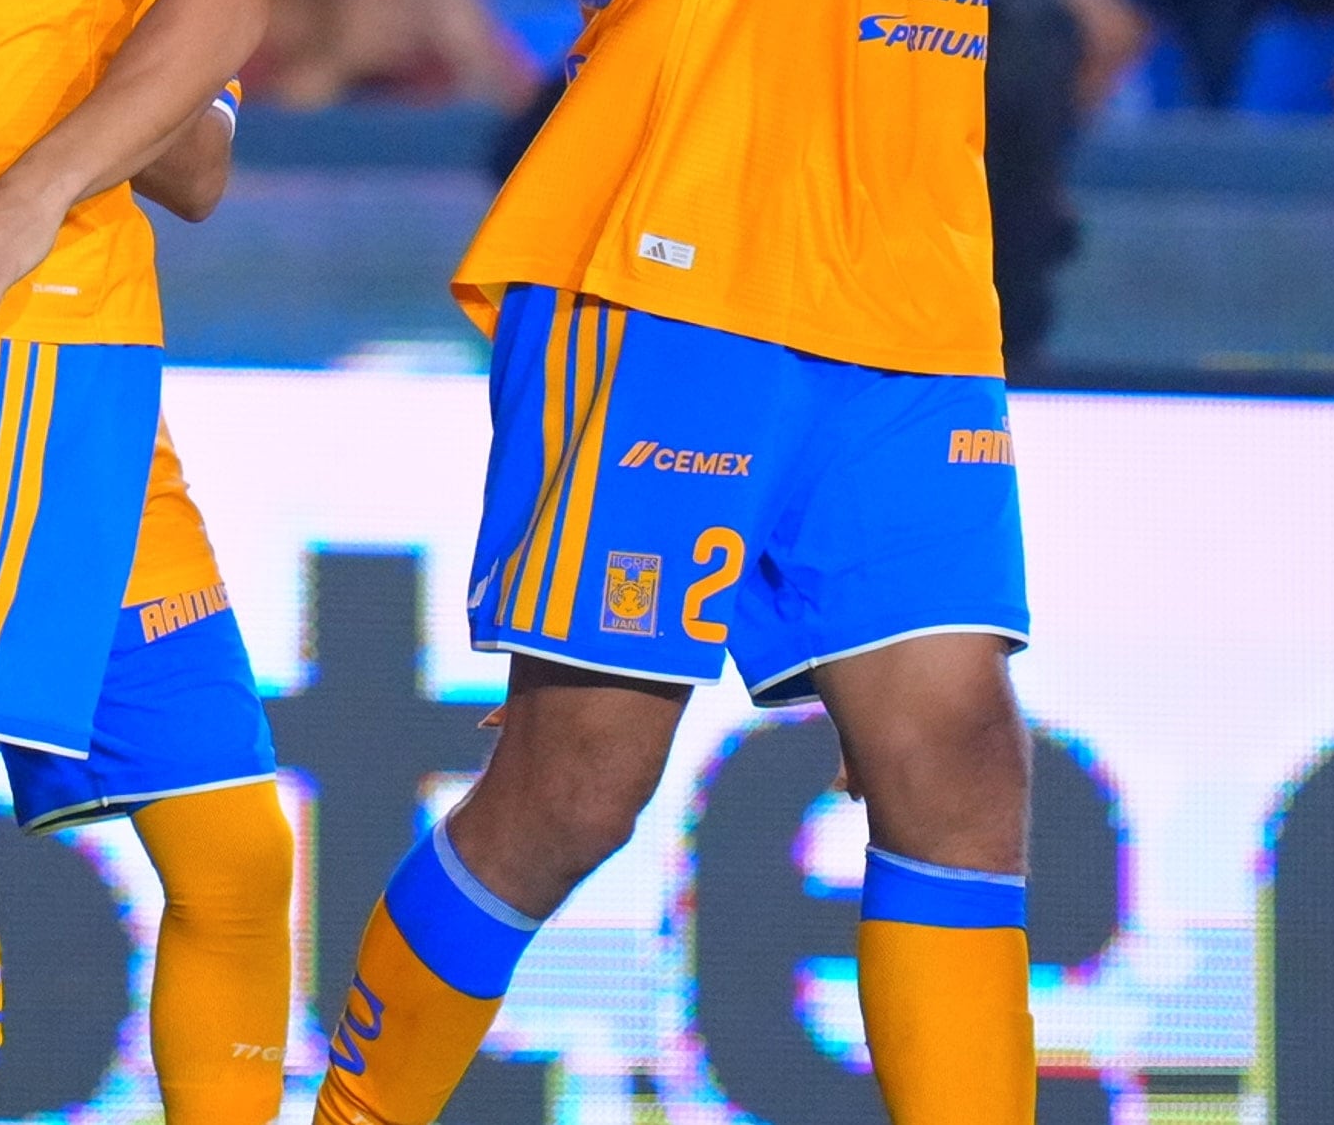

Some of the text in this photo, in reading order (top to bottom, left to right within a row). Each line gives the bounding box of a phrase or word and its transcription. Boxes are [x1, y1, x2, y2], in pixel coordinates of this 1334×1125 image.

[654, 448, 753, 477] CEMEX
[611, 555, 659, 572] TIGRES
[682, 527, 746, 644] 2
